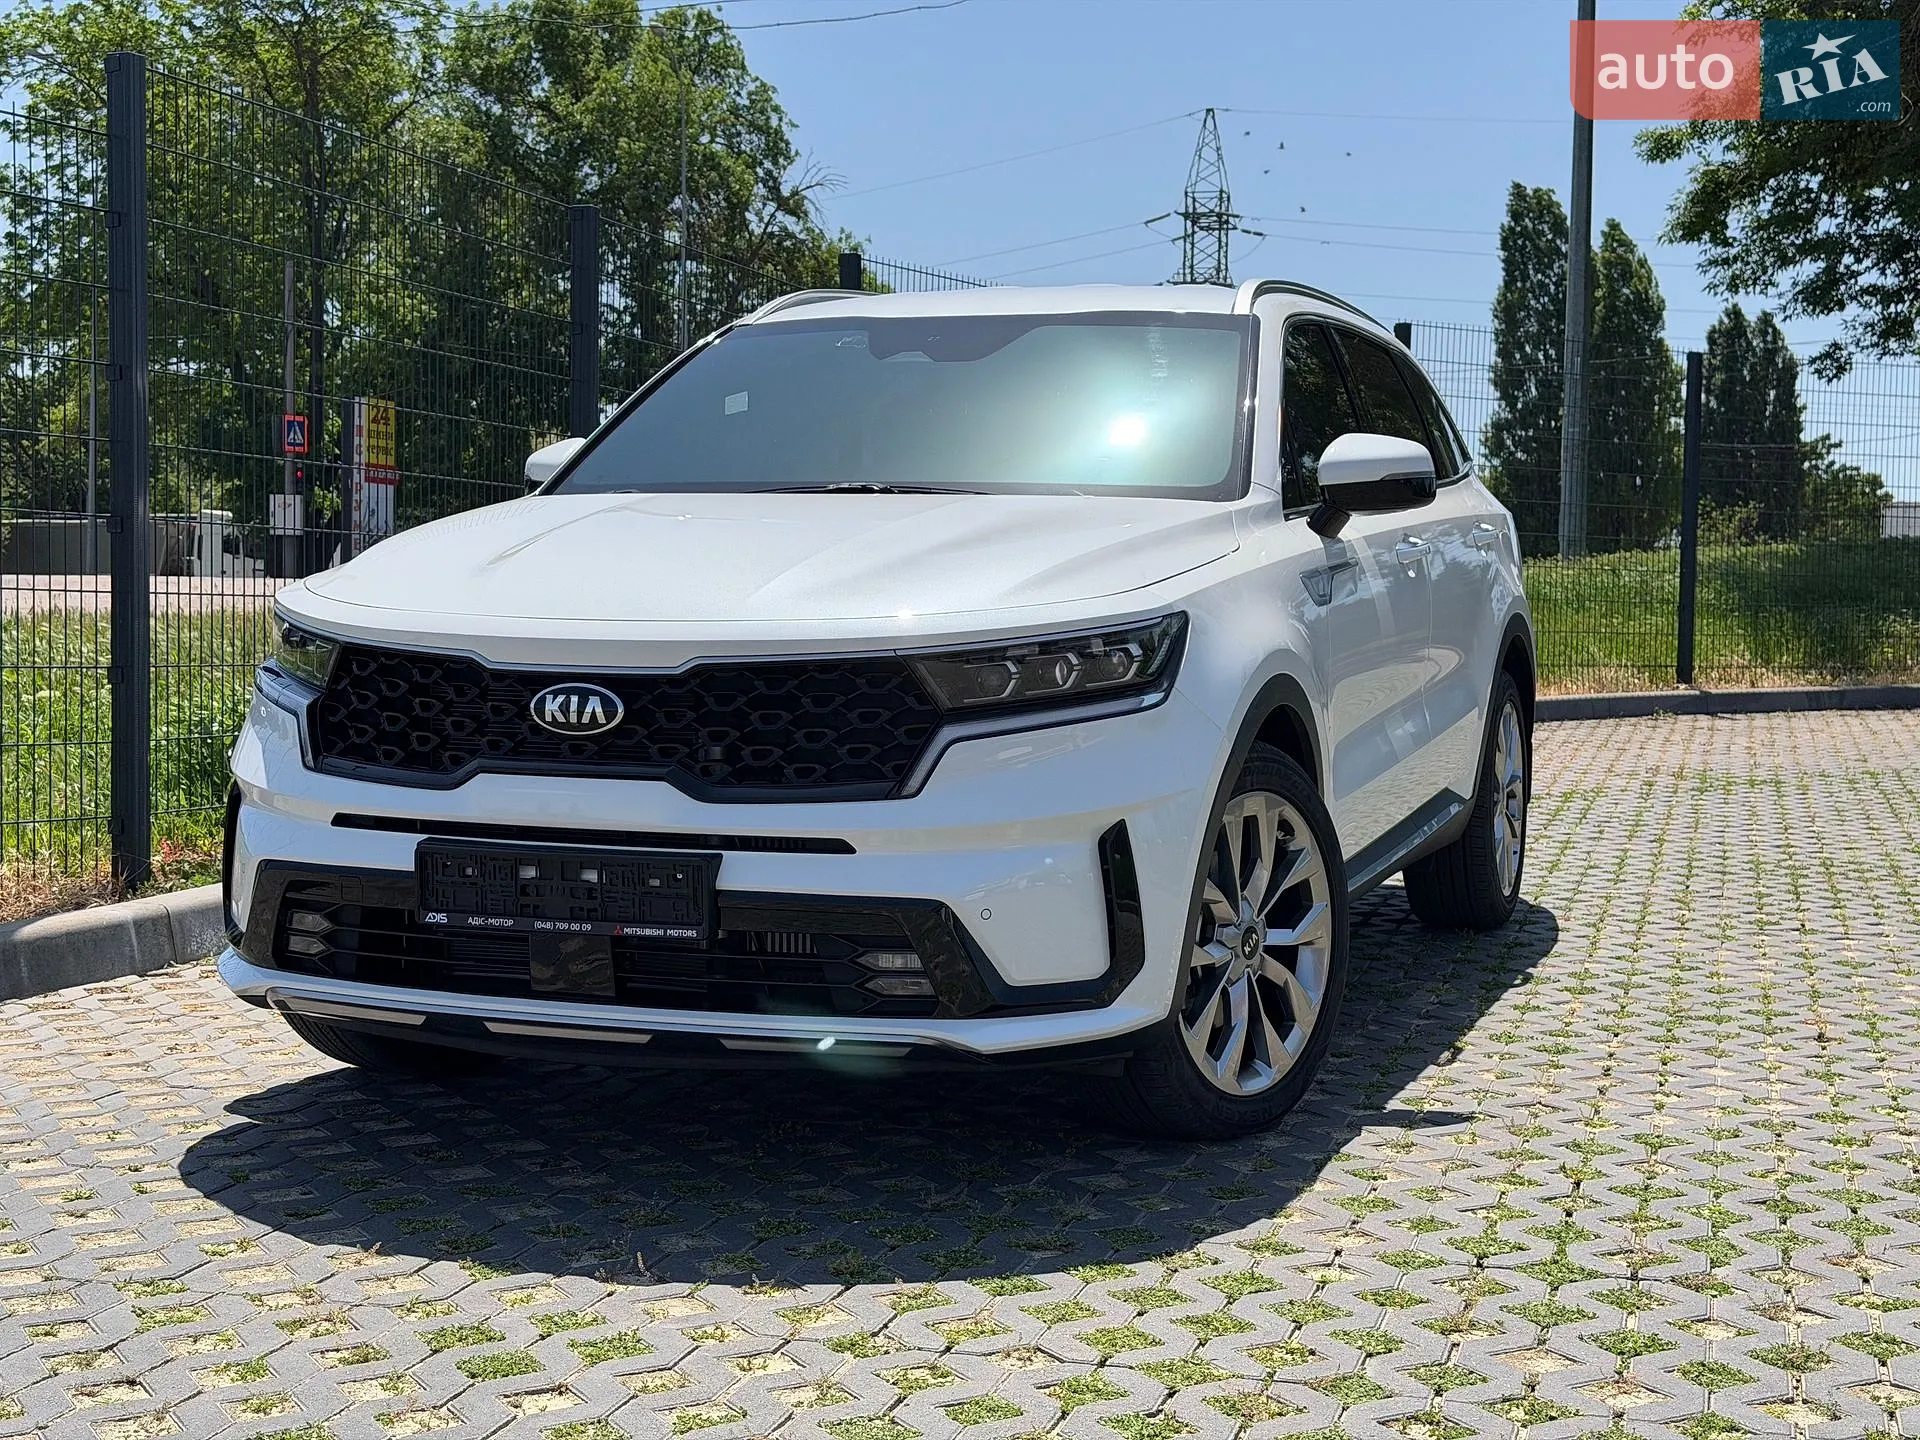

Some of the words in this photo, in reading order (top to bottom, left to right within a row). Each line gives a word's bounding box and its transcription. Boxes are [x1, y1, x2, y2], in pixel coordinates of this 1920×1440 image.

[544, 694, 607, 724] KIA
[424, 912, 448, 923] ADIS
[467, 916, 514, 927] АДІС-МОТОР
[534, 920, 554, 930] (048)
[555, 921, 569, 930] 709
[570, 922, 581, 931] 00
[581, 923, 592, 931] 09
[623, 927, 664, 936] MITSUBISHI
[667, 929, 697, 937] MOTORS
[1243, 932, 1259, 955] KIA
